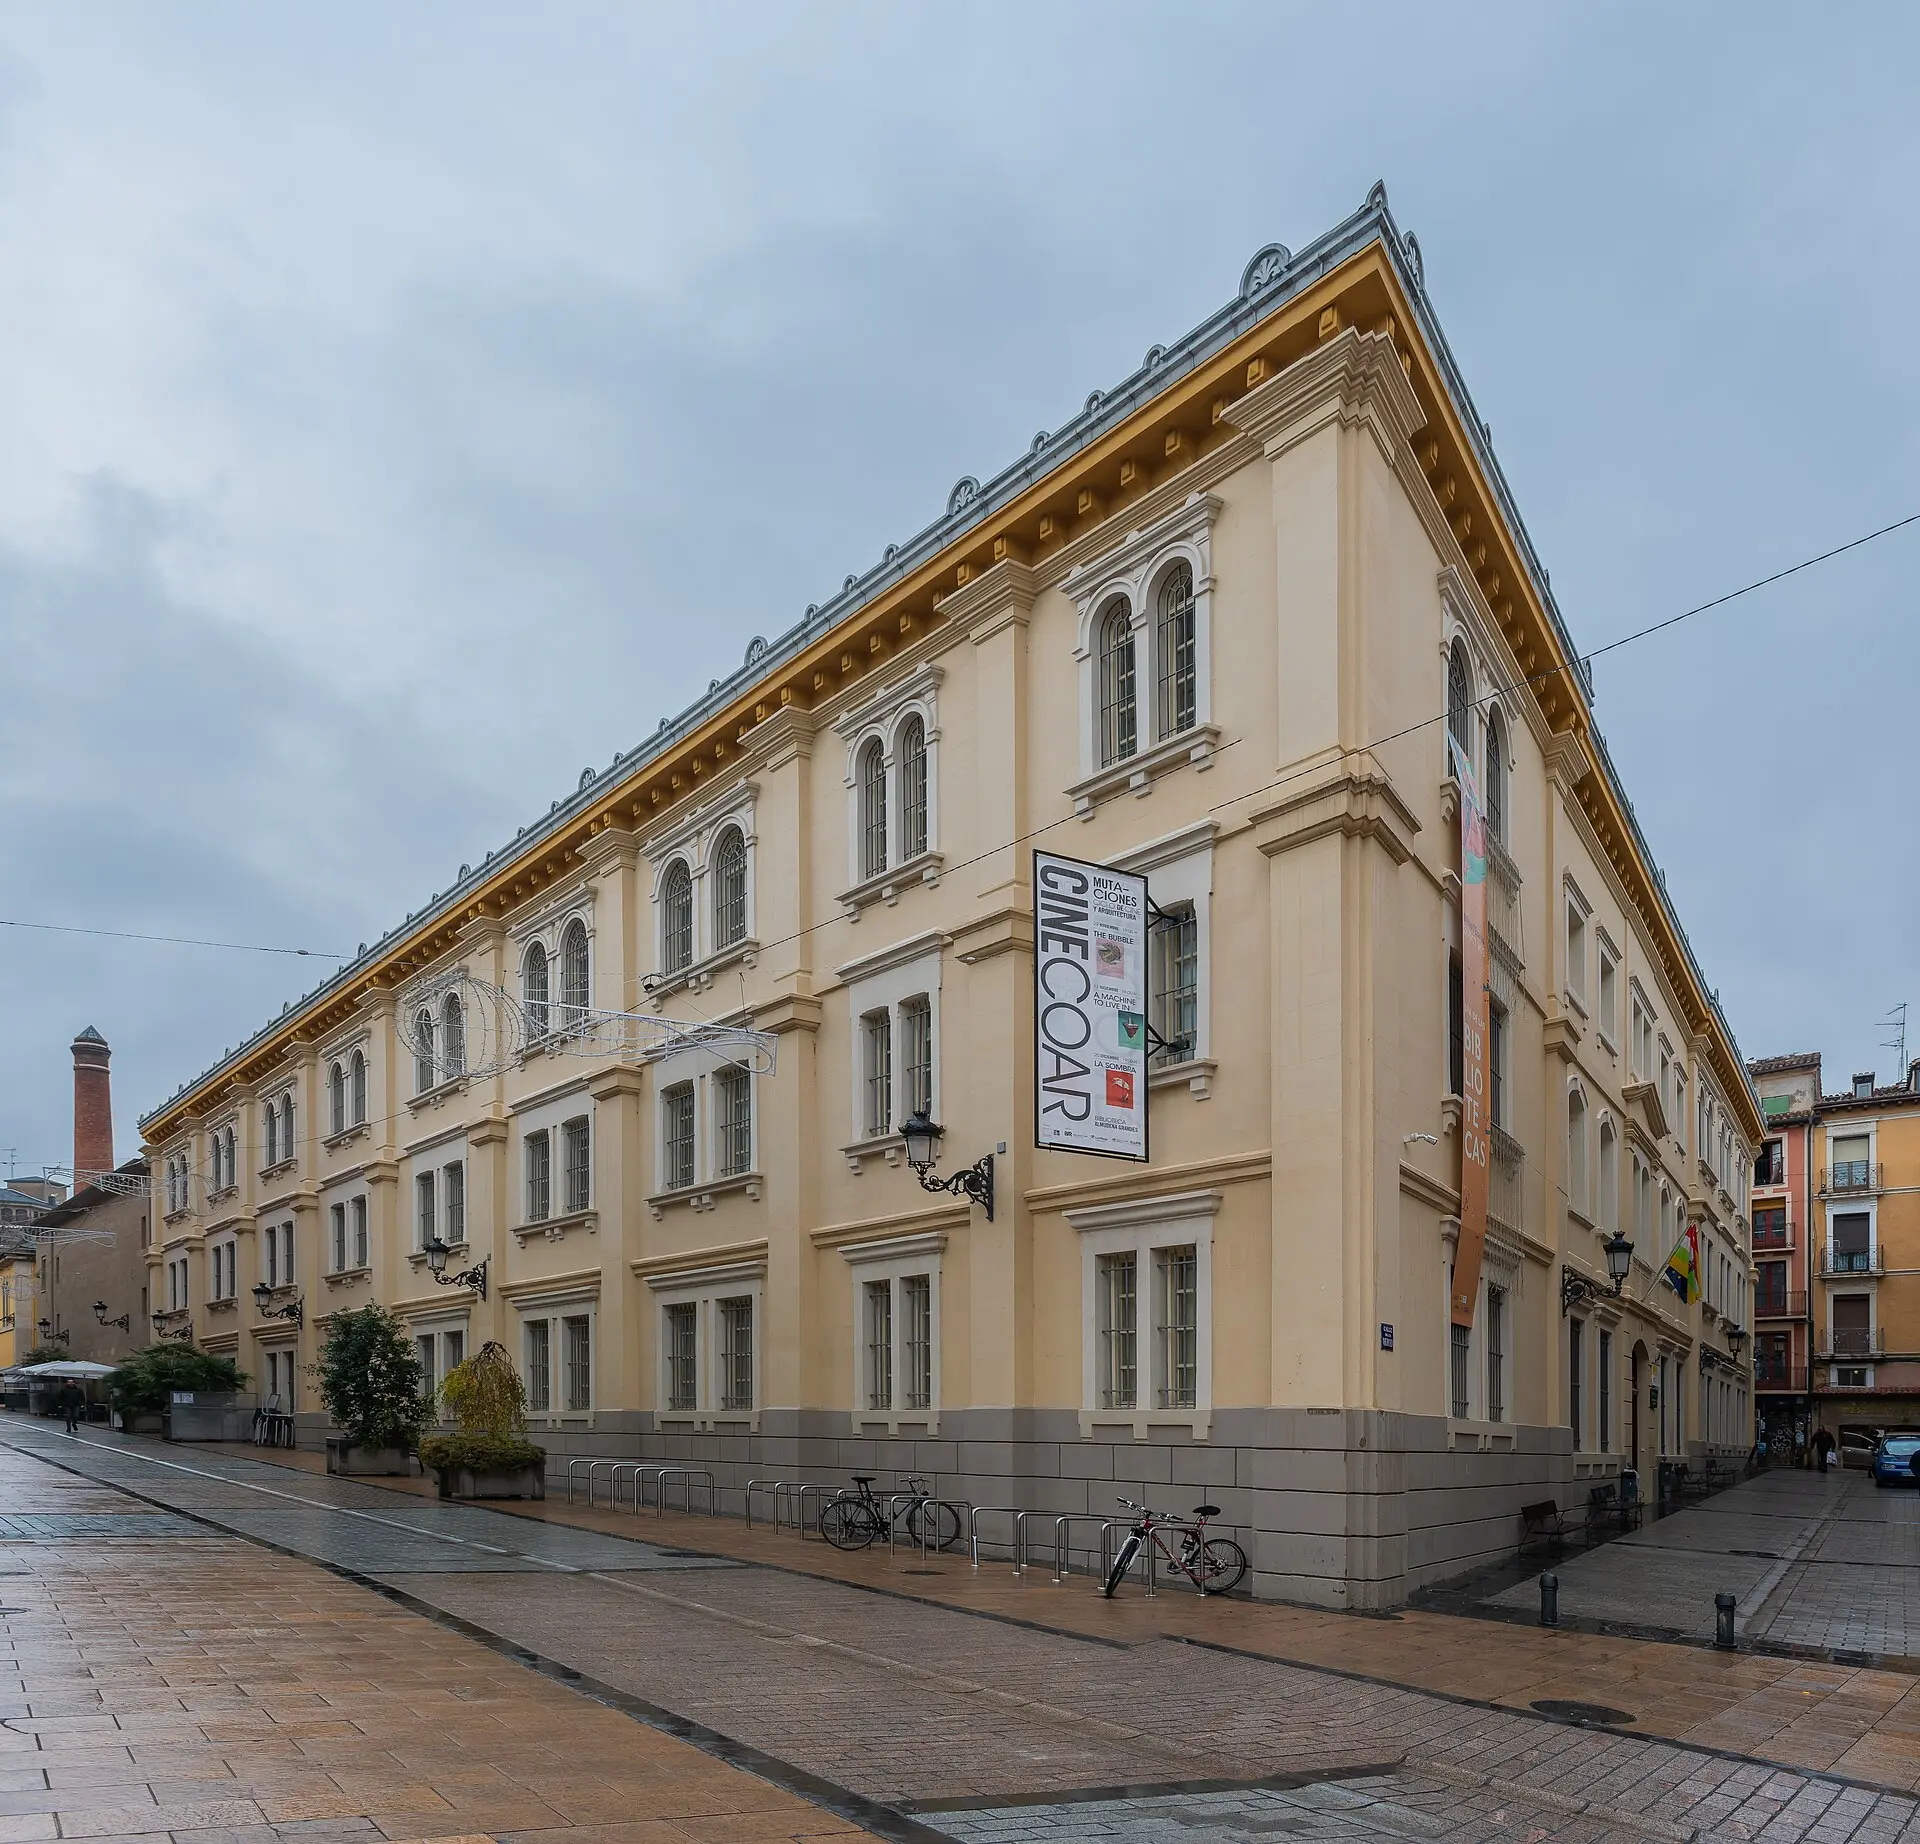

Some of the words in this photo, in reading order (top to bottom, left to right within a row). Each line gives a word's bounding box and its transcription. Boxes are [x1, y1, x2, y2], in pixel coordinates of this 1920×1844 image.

[1093, 876, 1129, 893] MUTA-
[1093, 888, 1137, 907] CIONES
[1097, 906, 1137, 921] ARQUITECTURA
[1116, 904, 1124, 912] DE
[1093, 930, 1107, 939] THE
[1108, 933, 1135, 945] BUBBLE
[1040, 865, 1091, 1121] CINECOAR
[1093, 991, 1100, 999] A
[1101, 992, 1137, 1006] MACHINE
[1093, 998, 1104, 1007] TO
[1105, 1000, 1120, 1010] LIVE
[1464, 1021, 1482, 1061] BIB
[1094, 1060, 1104, 1068] LA
[1105, 1061, 1137, 1074] SOMBRA
[1464, 1057, 1483, 1097] LIO
[1465, 1093, 1480, 1129] TE
[1094, 1115, 1127, 1125] BIBLIOTECA
[1094, 1121, 1118, 1130] ALMUDENA
[1118, 1124, 1139, 1133] GRANDES
[1464, 1130, 1487, 1168] CAS
